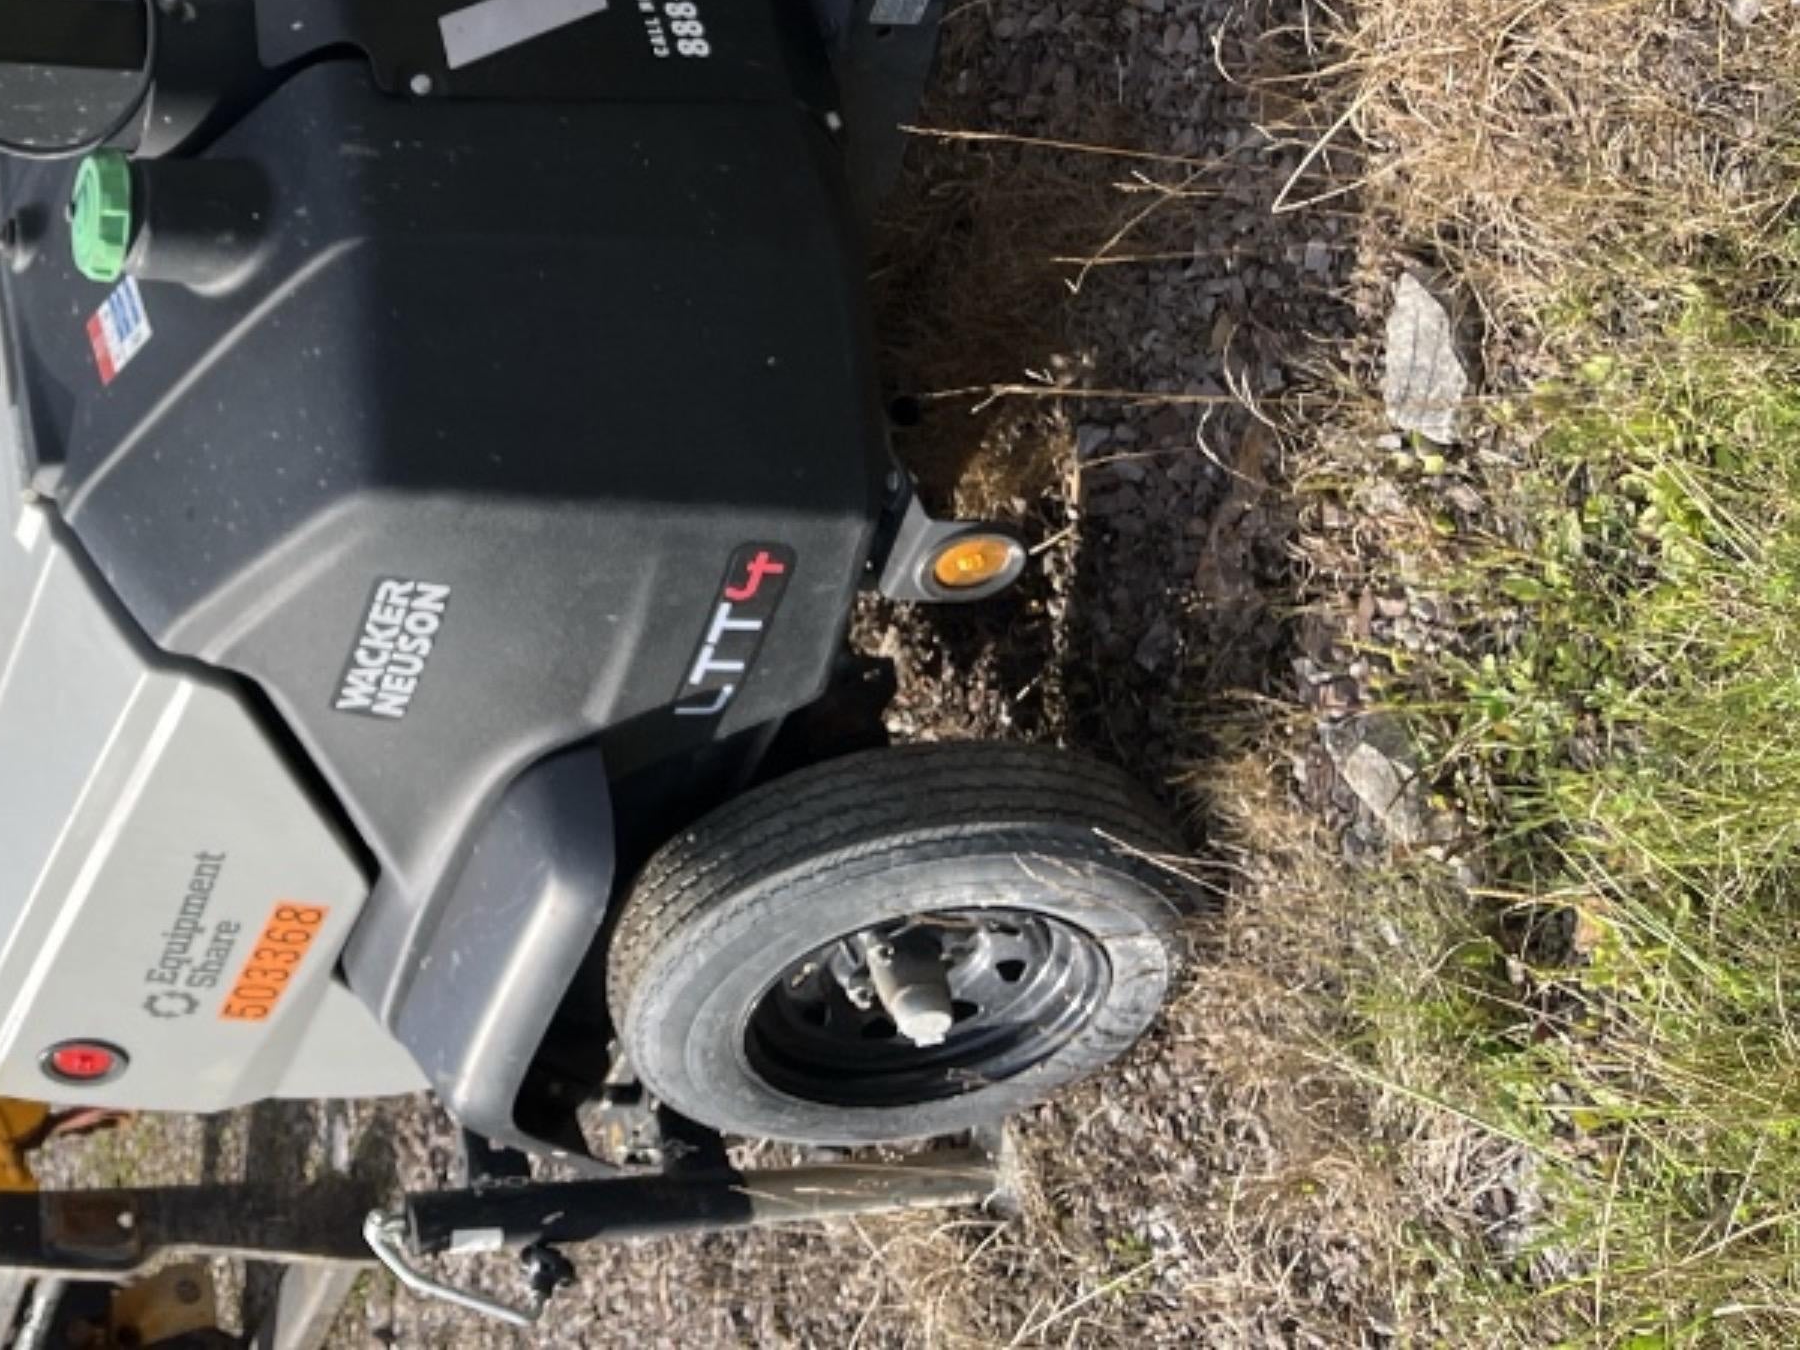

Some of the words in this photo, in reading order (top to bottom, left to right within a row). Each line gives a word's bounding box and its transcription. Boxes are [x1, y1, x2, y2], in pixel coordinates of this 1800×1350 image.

[644, 17, 671, 58] CALL
[335, 580, 416, 709] WACKER
[370, 581, 451, 718] NEUSON
[673, 551, 786, 715] LTT4
[144, 851, 227, 986] Equipment
[184, 919, 242, 989] Share
[222, 906, 323, 1020] 503368
